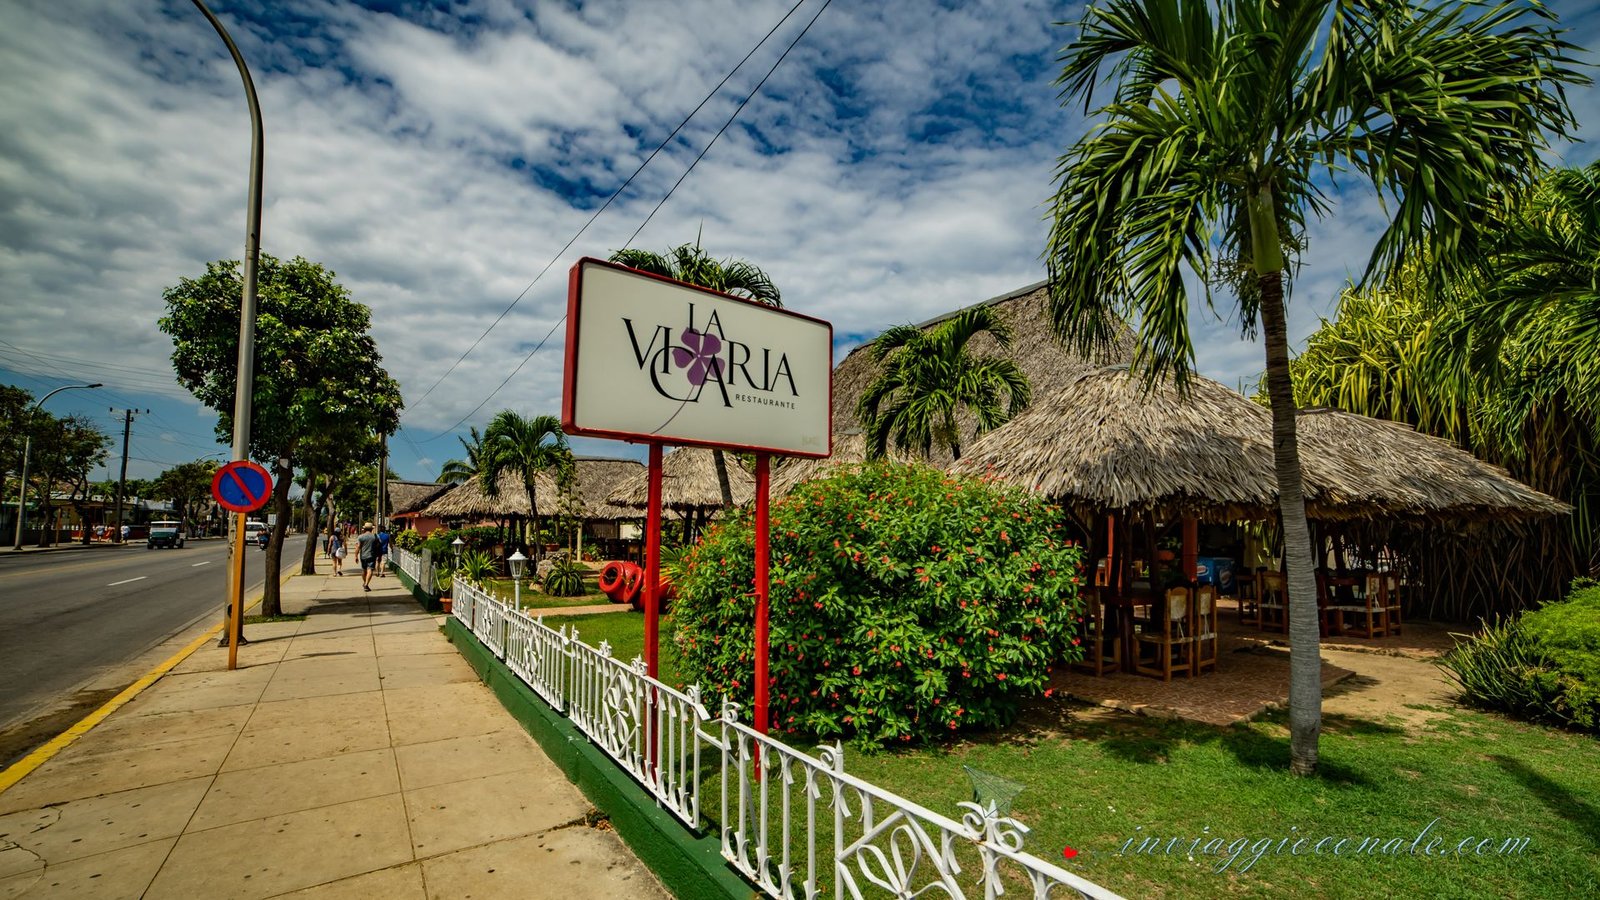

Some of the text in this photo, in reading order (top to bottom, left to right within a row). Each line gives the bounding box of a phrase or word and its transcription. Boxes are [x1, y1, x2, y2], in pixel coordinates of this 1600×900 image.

[688, 303, 726, 340] LA
[622, 317, 800, 408] VICARIA
[735, 394, 796, 410] RESTAURANTE
